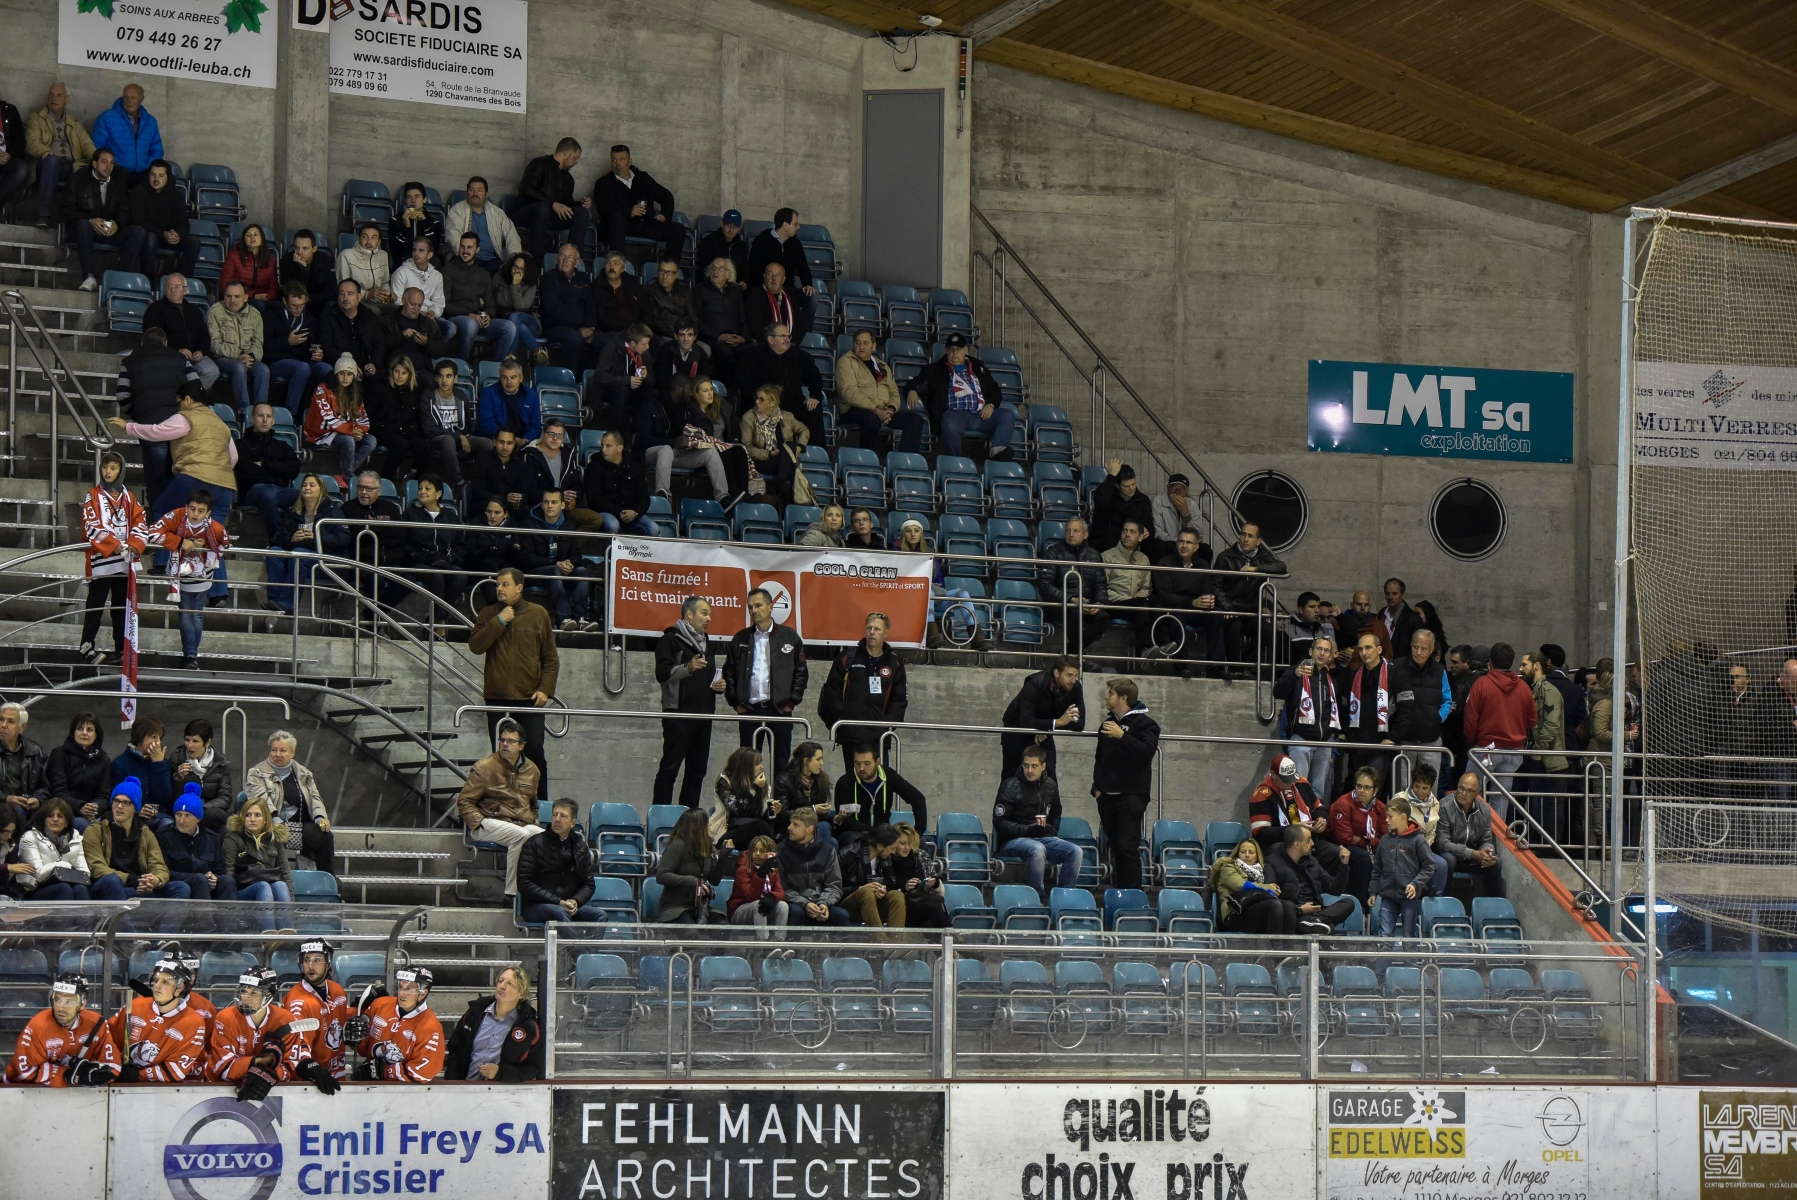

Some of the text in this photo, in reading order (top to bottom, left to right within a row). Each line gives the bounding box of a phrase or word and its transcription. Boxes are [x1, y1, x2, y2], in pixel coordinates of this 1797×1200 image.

[119, 4, 220, 25] SOINS AUX ARBRES
[358, 0, 483, 34] SARDIS
[116, 26, 222, 52] 079 449 26 27
[354, 28, 523, 60] SOCIETE FIDUCIAIRE SA
[86, 49, 252, 79] www.woodtli-leuba.ch
[329, 66, 387, 82] 022 779 17 31
[353, 52, 494, 77] www.sardisfiduciaire.com
[346, 79, 362, 90] 489
[364, 81, 375, 91] 09
[377, 83, 388, 92] 60
[441, 81, 462, 92] Route
[464, 84, 473, 93] de
[475, 86, 481, 94] la
[483, 86, 522, 98] Branvaude
[425, 89, 522, 107] 1290 Chavannes des Bois
[1352, 370, 1477, 429] LMT
[1657, 388, 1695, 399] verres
[1751, 389, 1772, 401] des
[1481, 400, 1531, 432] sa
[1420, 432, 1531, 453] exploitation
[1634, 444, 1700, 459] MORGES
[1714, 448, 1776, 462] 021/804
[621, 566, 709, 587] Sans fumée !
[814, 563, 898, 580] COOL & CLEAN
[870, 581, 879, 589] the
[879, 582, 898, 590] SPIRIT
[620, 586, 742, 608] Ici et mainnant.
[104, 1043, 114, 1061] 2
[18, 1055, 29, 1072] 2
[415, 1057, 430, 1071] 7
[1332, 1098, 1404, 1118] GARAGE
[581, 1102, 861, 1144] FEHLMANN
[1063, 1086, 1211, 1152] qualité
[299, 1121, 546, 1164] Emil Frey SA
[1331, 1131, 1464, 1155] EDELWEISS
[174, 1151, 274, 1171] VOLVO
[1541, 1149, 1584, 1163] OPEL
[1704, 1154, 1743, 1179] SA
[298, 1159, 445, 1196] Crissier
[577, 1158, 922, 1200] ARCHITECTES
[1021, 1152, 1250, 1200] choix prix
[1363, 1159, 1550, 1195] Votre partenaire à Morges
